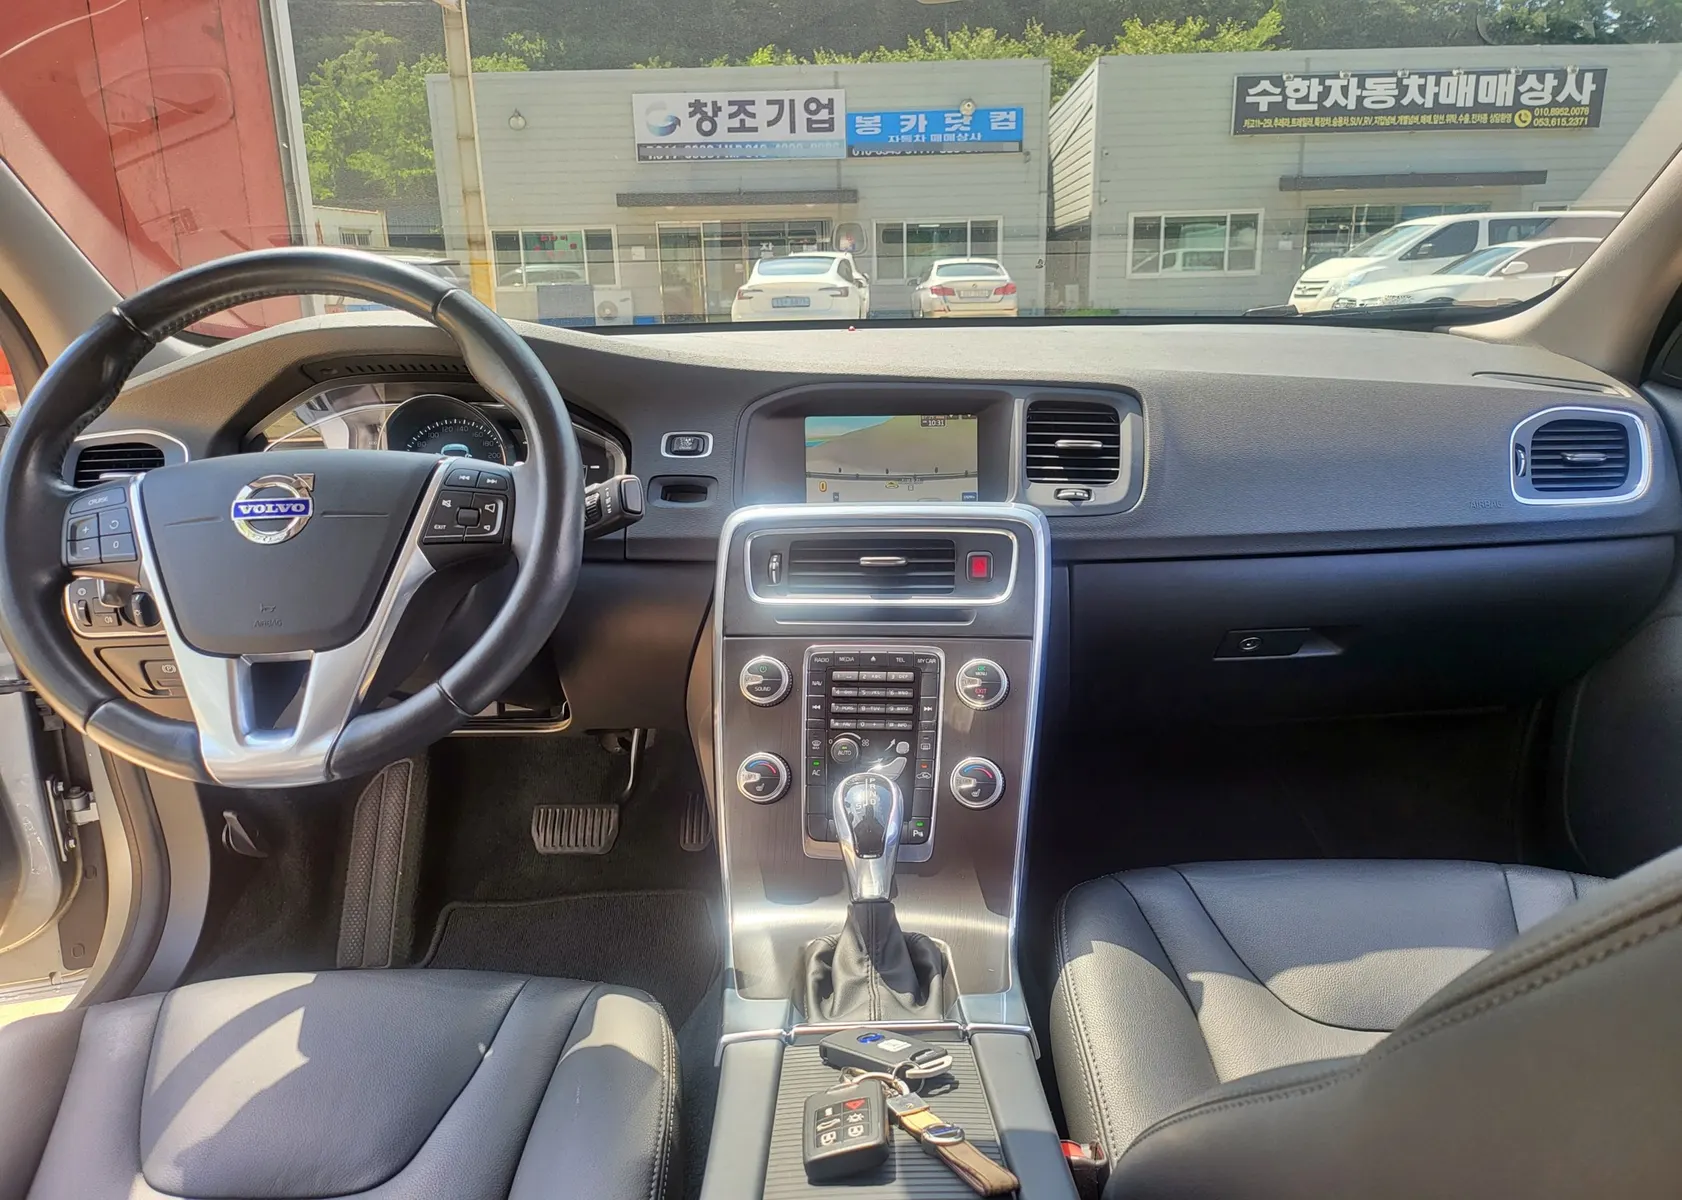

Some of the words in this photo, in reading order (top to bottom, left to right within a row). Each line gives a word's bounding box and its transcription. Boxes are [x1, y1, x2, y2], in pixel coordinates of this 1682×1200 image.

[1245, 72, 1597, 112] 수한자동차매매상사
[688, 97, 835, 137] 창조기업
[238, 503, 305, 514] VOLVO
[1470, 500, 1503, 509] AIRBAG
